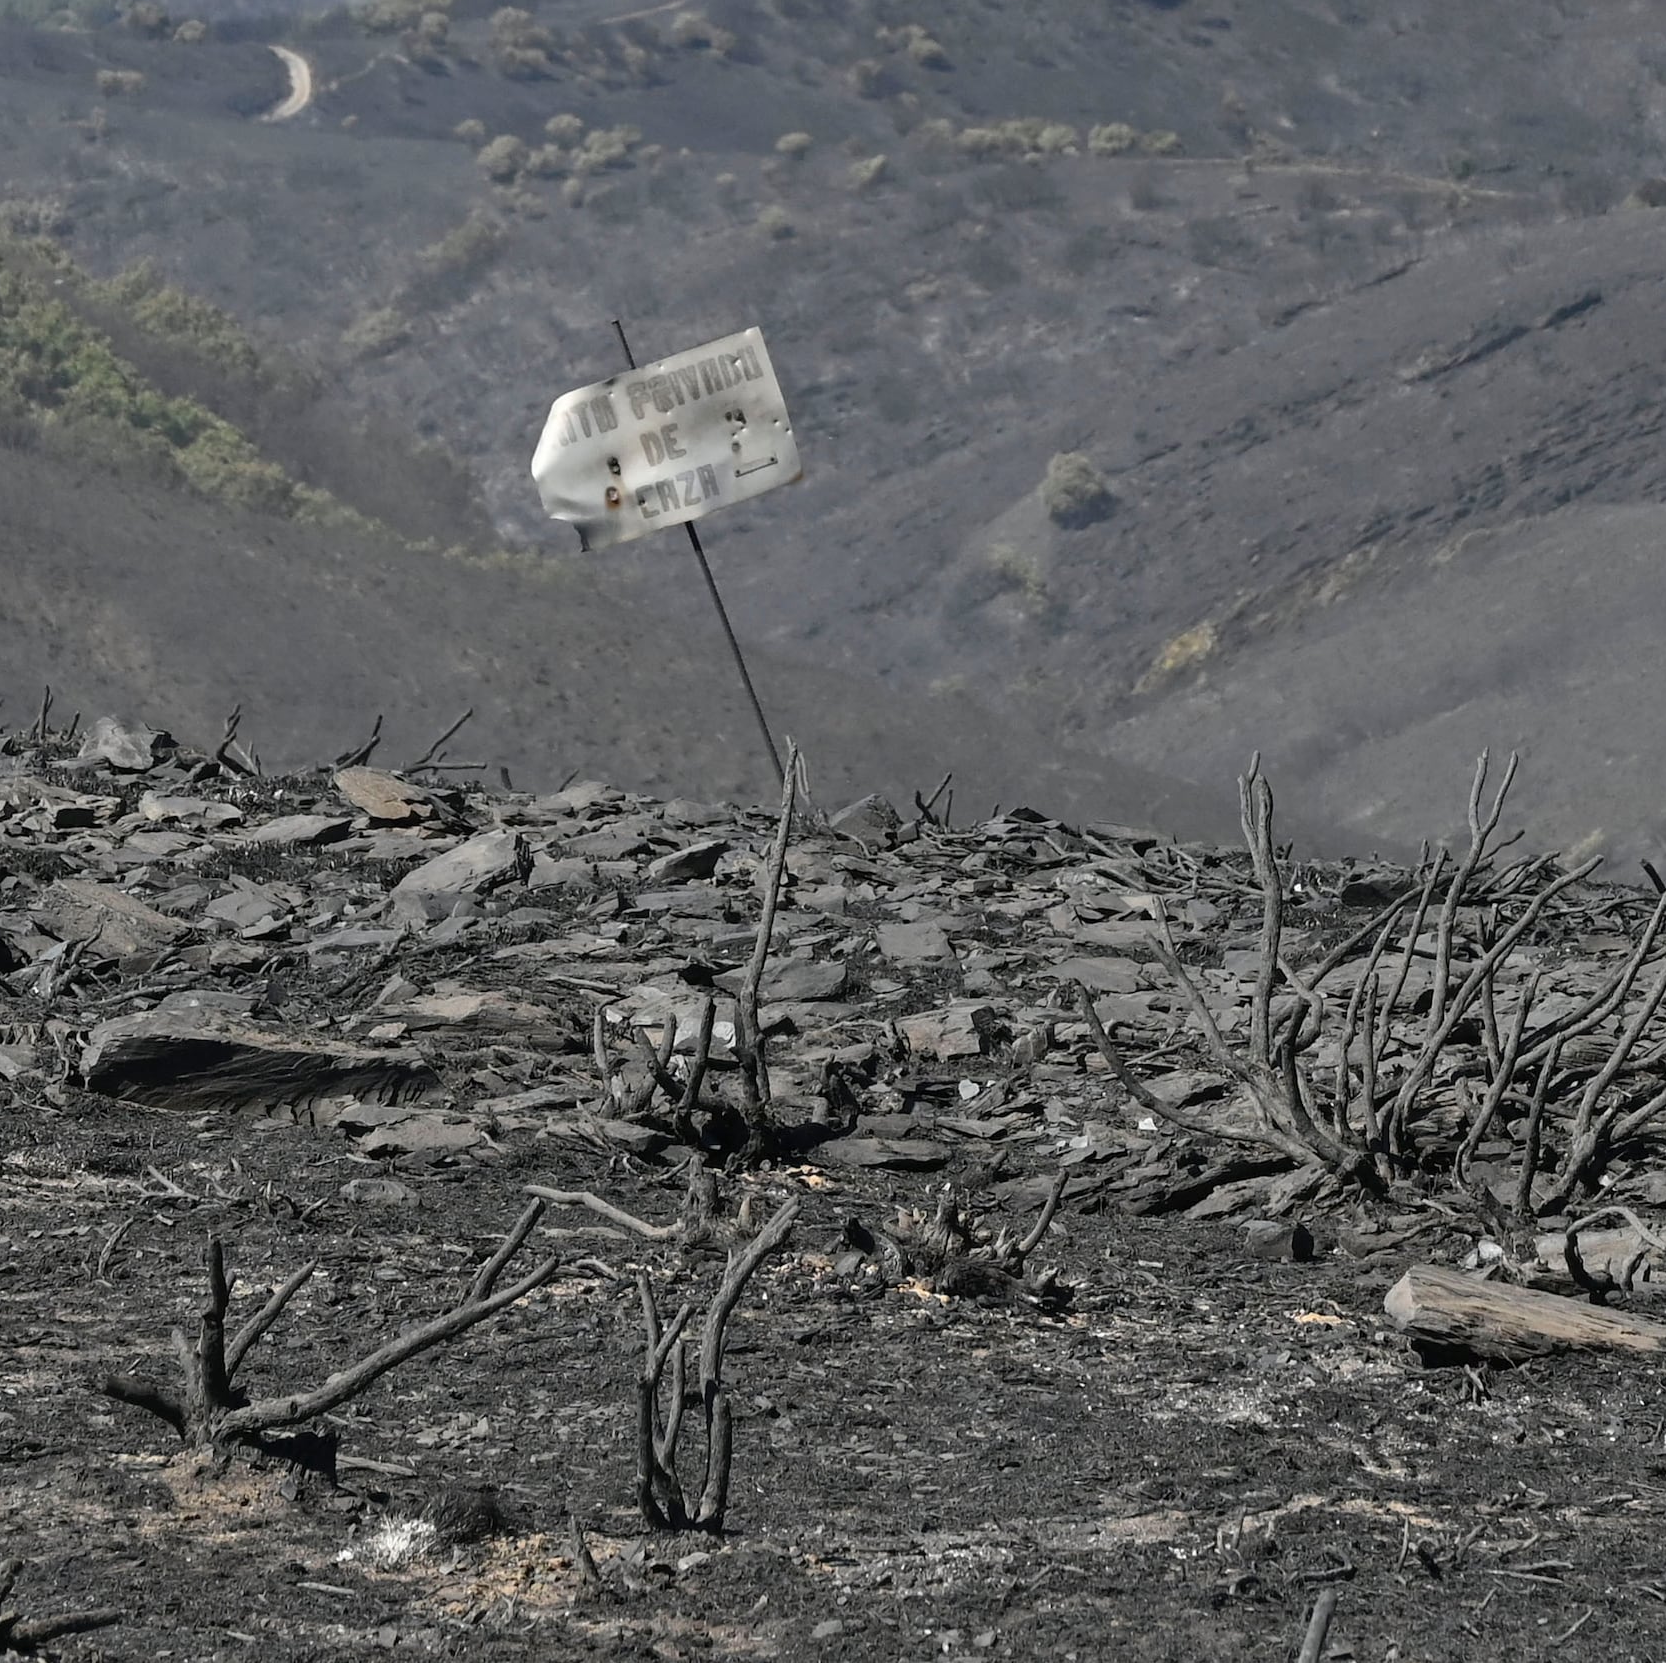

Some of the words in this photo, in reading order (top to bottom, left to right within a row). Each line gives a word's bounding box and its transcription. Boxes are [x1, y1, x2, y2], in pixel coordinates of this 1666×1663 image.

[626, 345, 764, 420] PRIVADO
[639, 423, 687, 467] DE
[635, 463, 720, 519] CAZA
